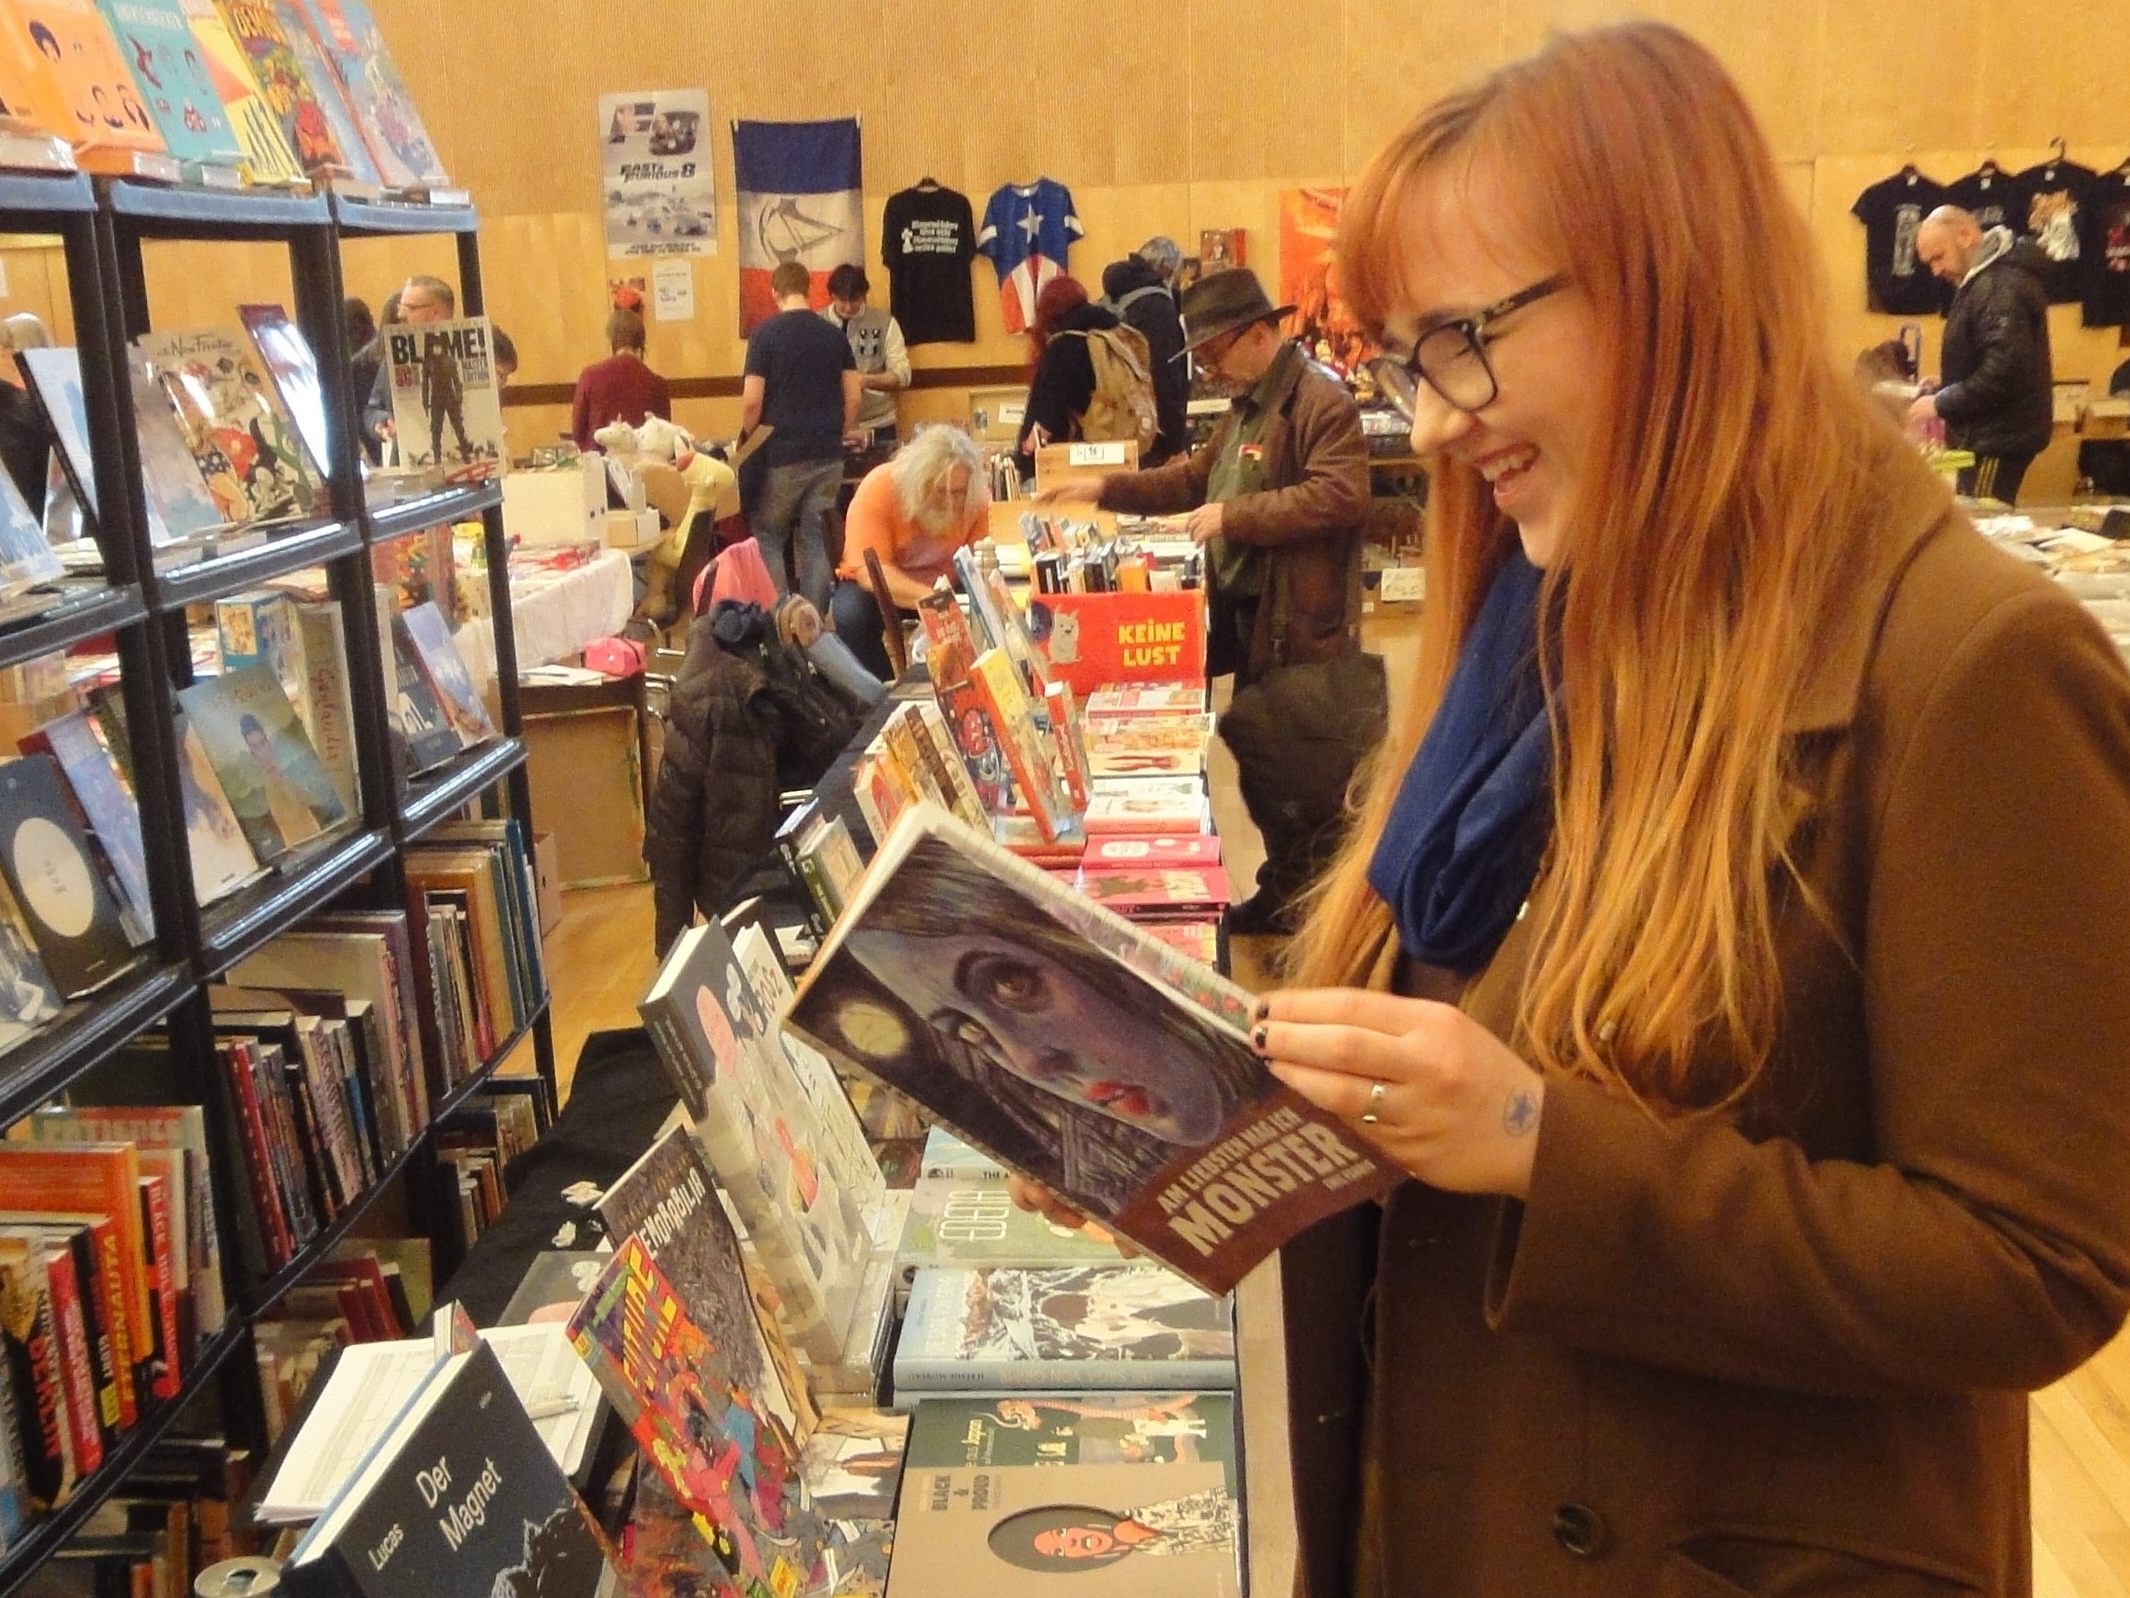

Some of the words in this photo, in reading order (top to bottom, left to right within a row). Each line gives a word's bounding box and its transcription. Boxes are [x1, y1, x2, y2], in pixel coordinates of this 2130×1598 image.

[390, 327, 486, 365] BLAME!
[1123, 645, 1181, 667] LUST
[1156, 1182, 1191, 1214] AM
[1179, 1135, 1251, 1191] LIEBSTEN
[1239, 1120, 1278, 1148] MAG
[1267, 1106, 1302, 1133] ICH
[638, 1166, 707, 1261] EMORABILIA
[1168, 1121, 1360, 1258] MONSTER
[415, 1455, 453, 1508] Der
[439, 1456, 503, 1551] Magnet
[931, 1474, 951, 1511] BLACK
[971, 1473, 990, 1510] PROUD
[368, 1522, 404, 1571] Lucas
